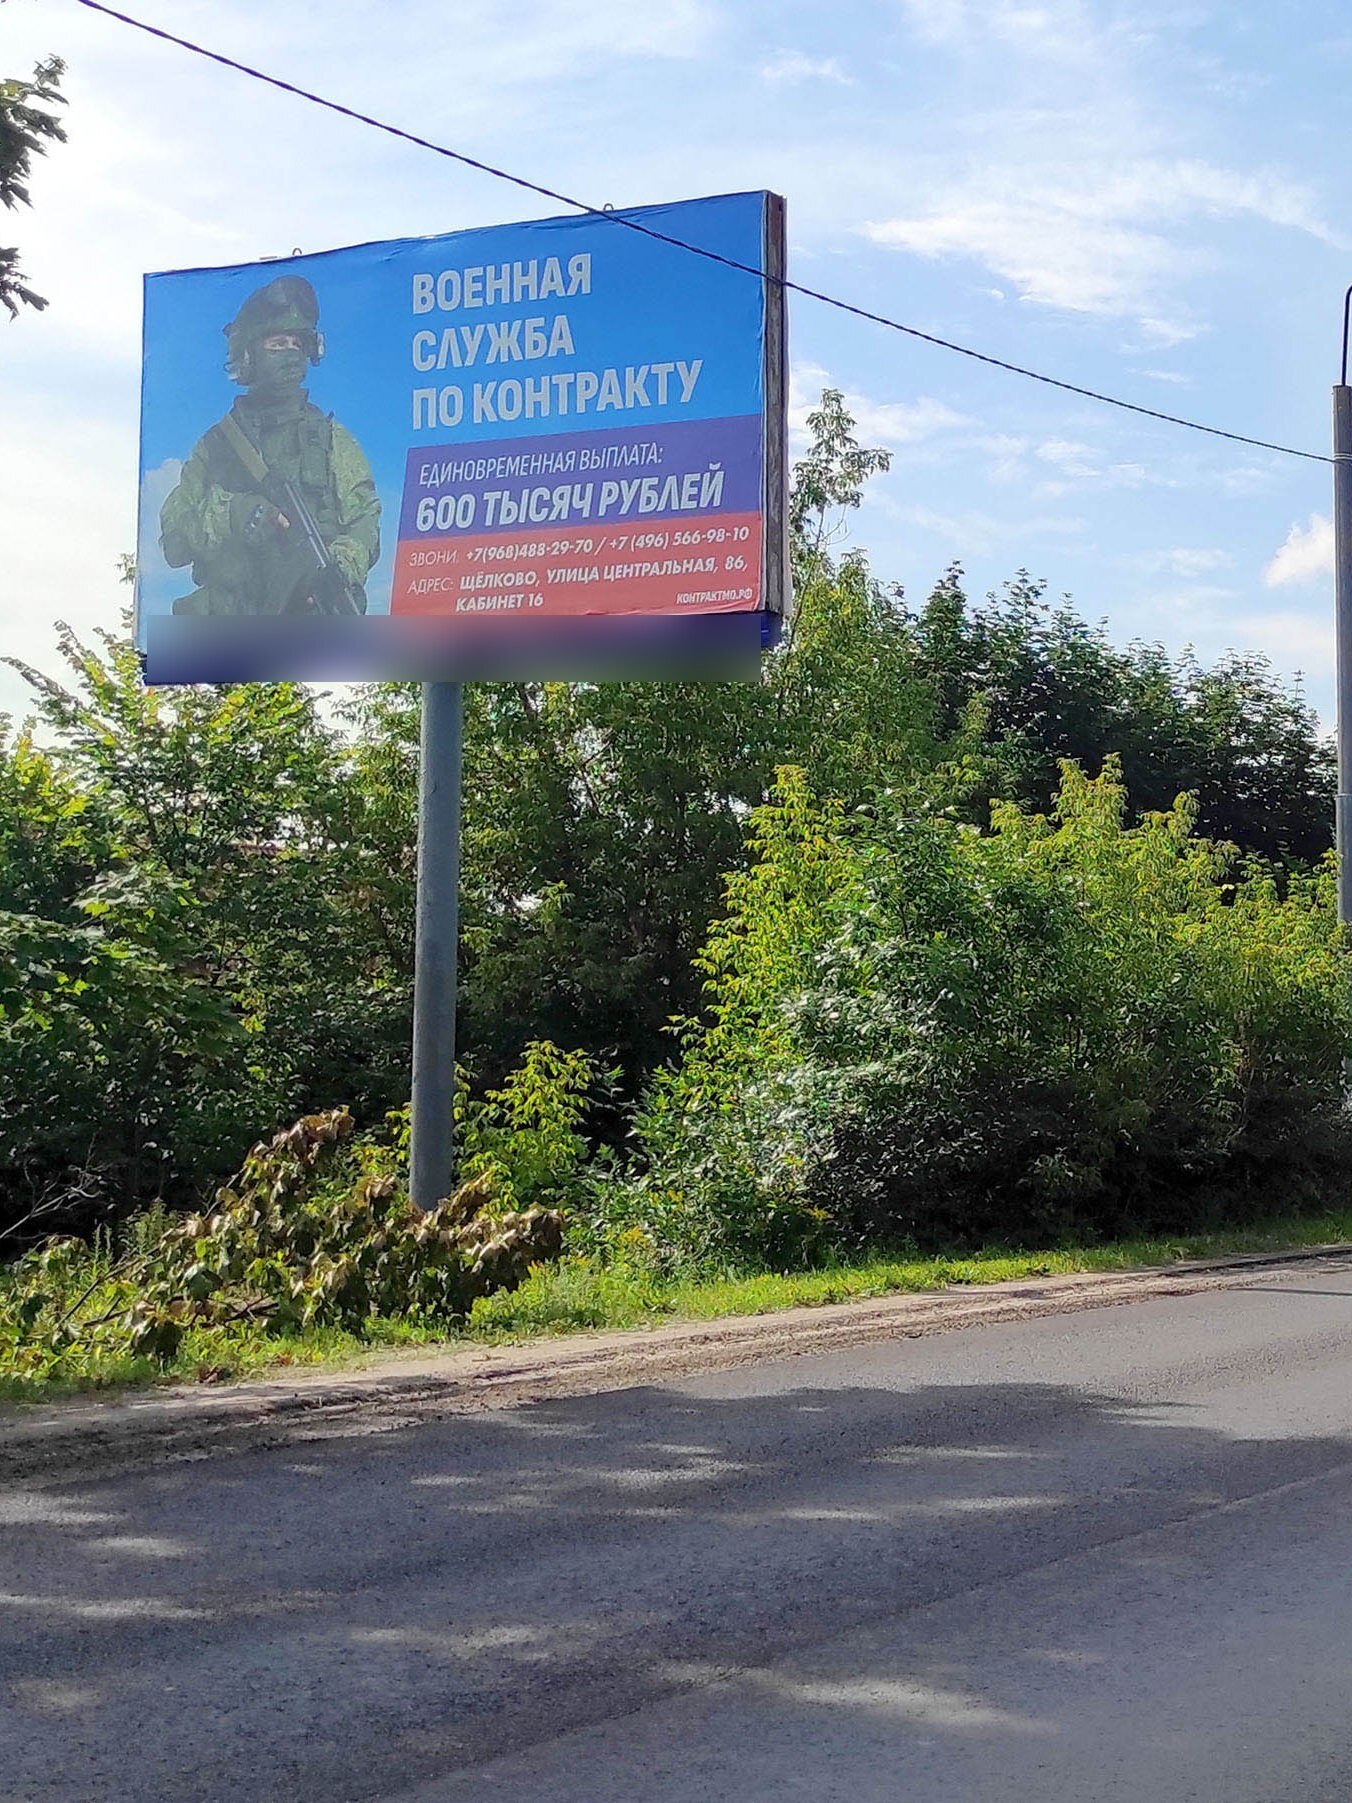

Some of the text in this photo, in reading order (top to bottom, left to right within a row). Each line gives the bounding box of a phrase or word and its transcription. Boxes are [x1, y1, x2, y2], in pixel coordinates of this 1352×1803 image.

[412, 253, 592, 315] ВОЕННАЯ
[412, 314, 576, 372] СЛУЖБА
[412, 359, 704, 430] ПО КОНТРАКТУ
[419, 442, 664, 488] ЕДИНОВРЕМЕННАЯ ВЫПЛАТА:
[416, 462, 725, 532] 600 ТЫСЯЧ РУБЛЕЙ
[609, 536, 629, 550] +7
[630, 532, 669, 552] (496)
[672, 526, 750, 546] 566-98-10
[407, 555, 748, 596] АДРЕС: ЩЁЛКОВО, УЛИЦА ЦЕНТРАЛЬНАЯ, 86,
[676, 587, 753, 604] КОНТРАКТМО.РФ
[455, 593, 544, 612] КАБИНЕТ 16
